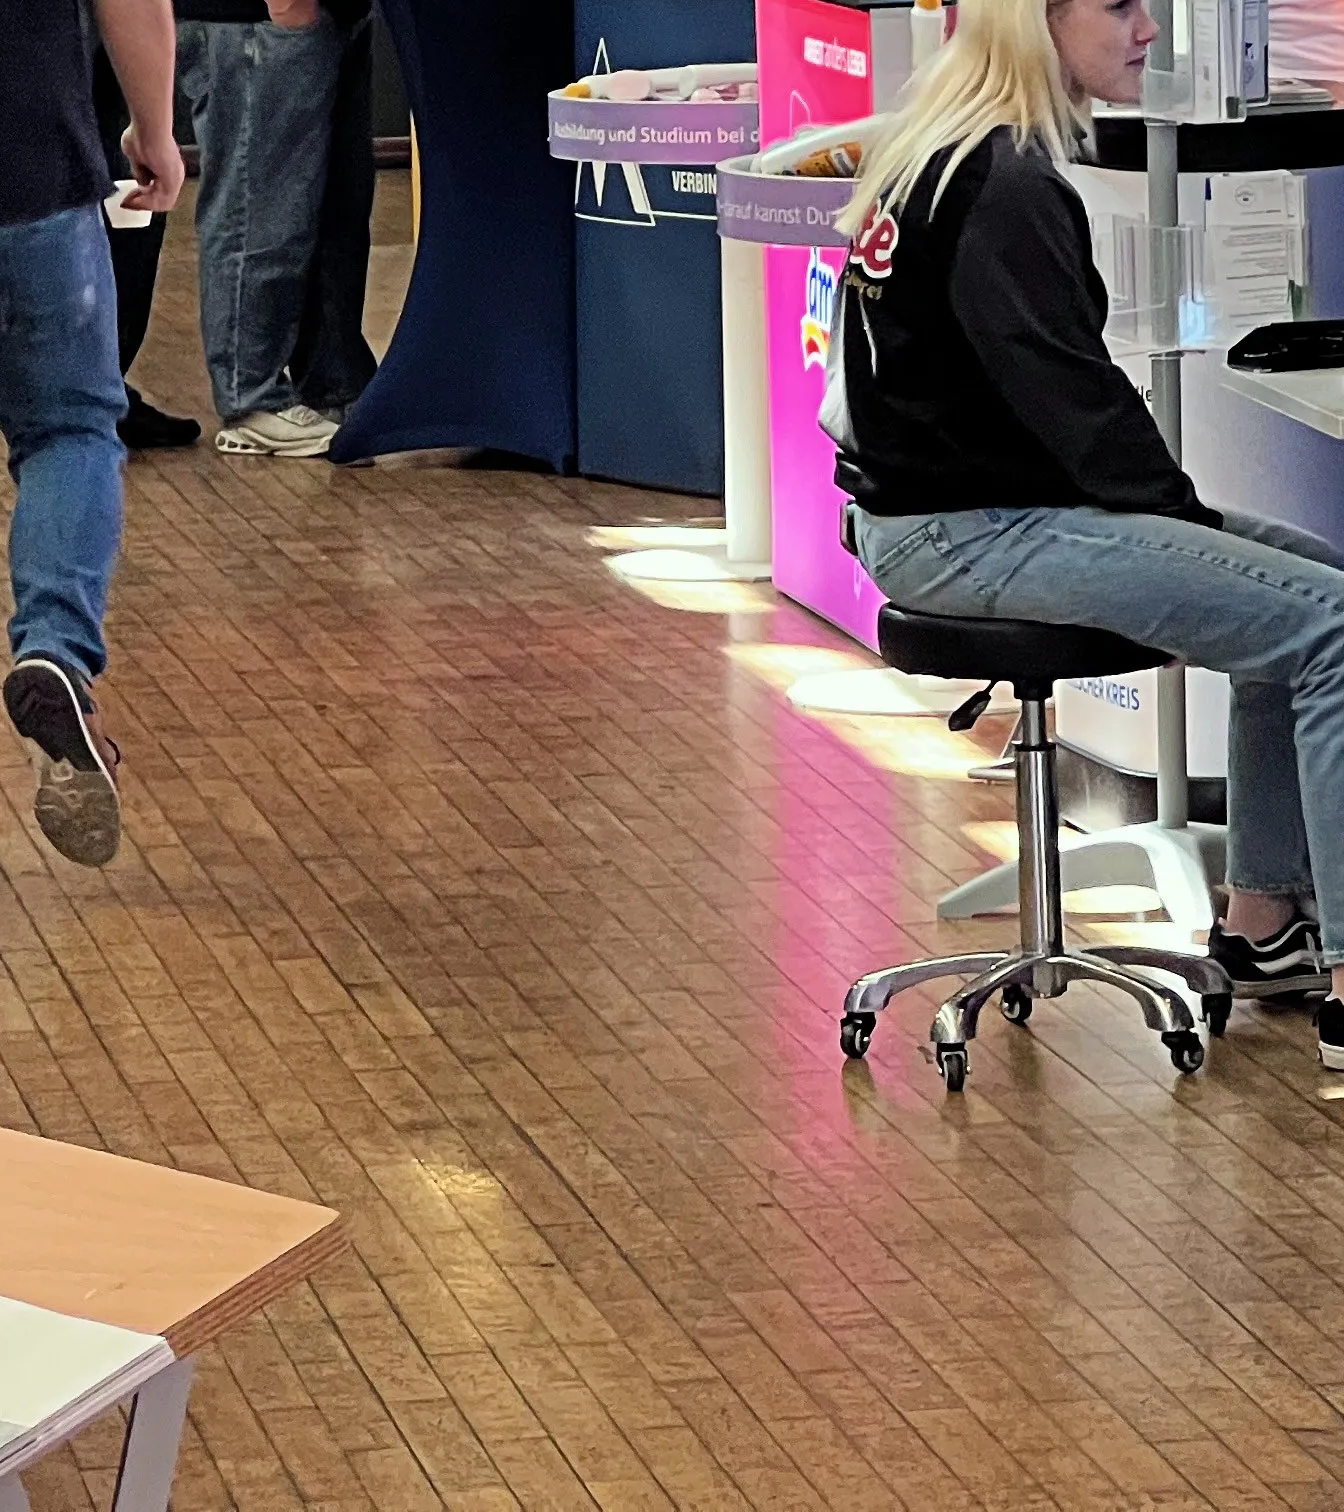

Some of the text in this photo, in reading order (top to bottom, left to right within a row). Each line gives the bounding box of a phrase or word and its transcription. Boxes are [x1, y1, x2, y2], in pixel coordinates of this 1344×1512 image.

[608, 126, 636, 144] und
[640, 127, 712, 144] Studium
[717, 127, 745, 144] bei
[755, 203, 801, 225] kannst
[806, 207, 830, 225] Du
